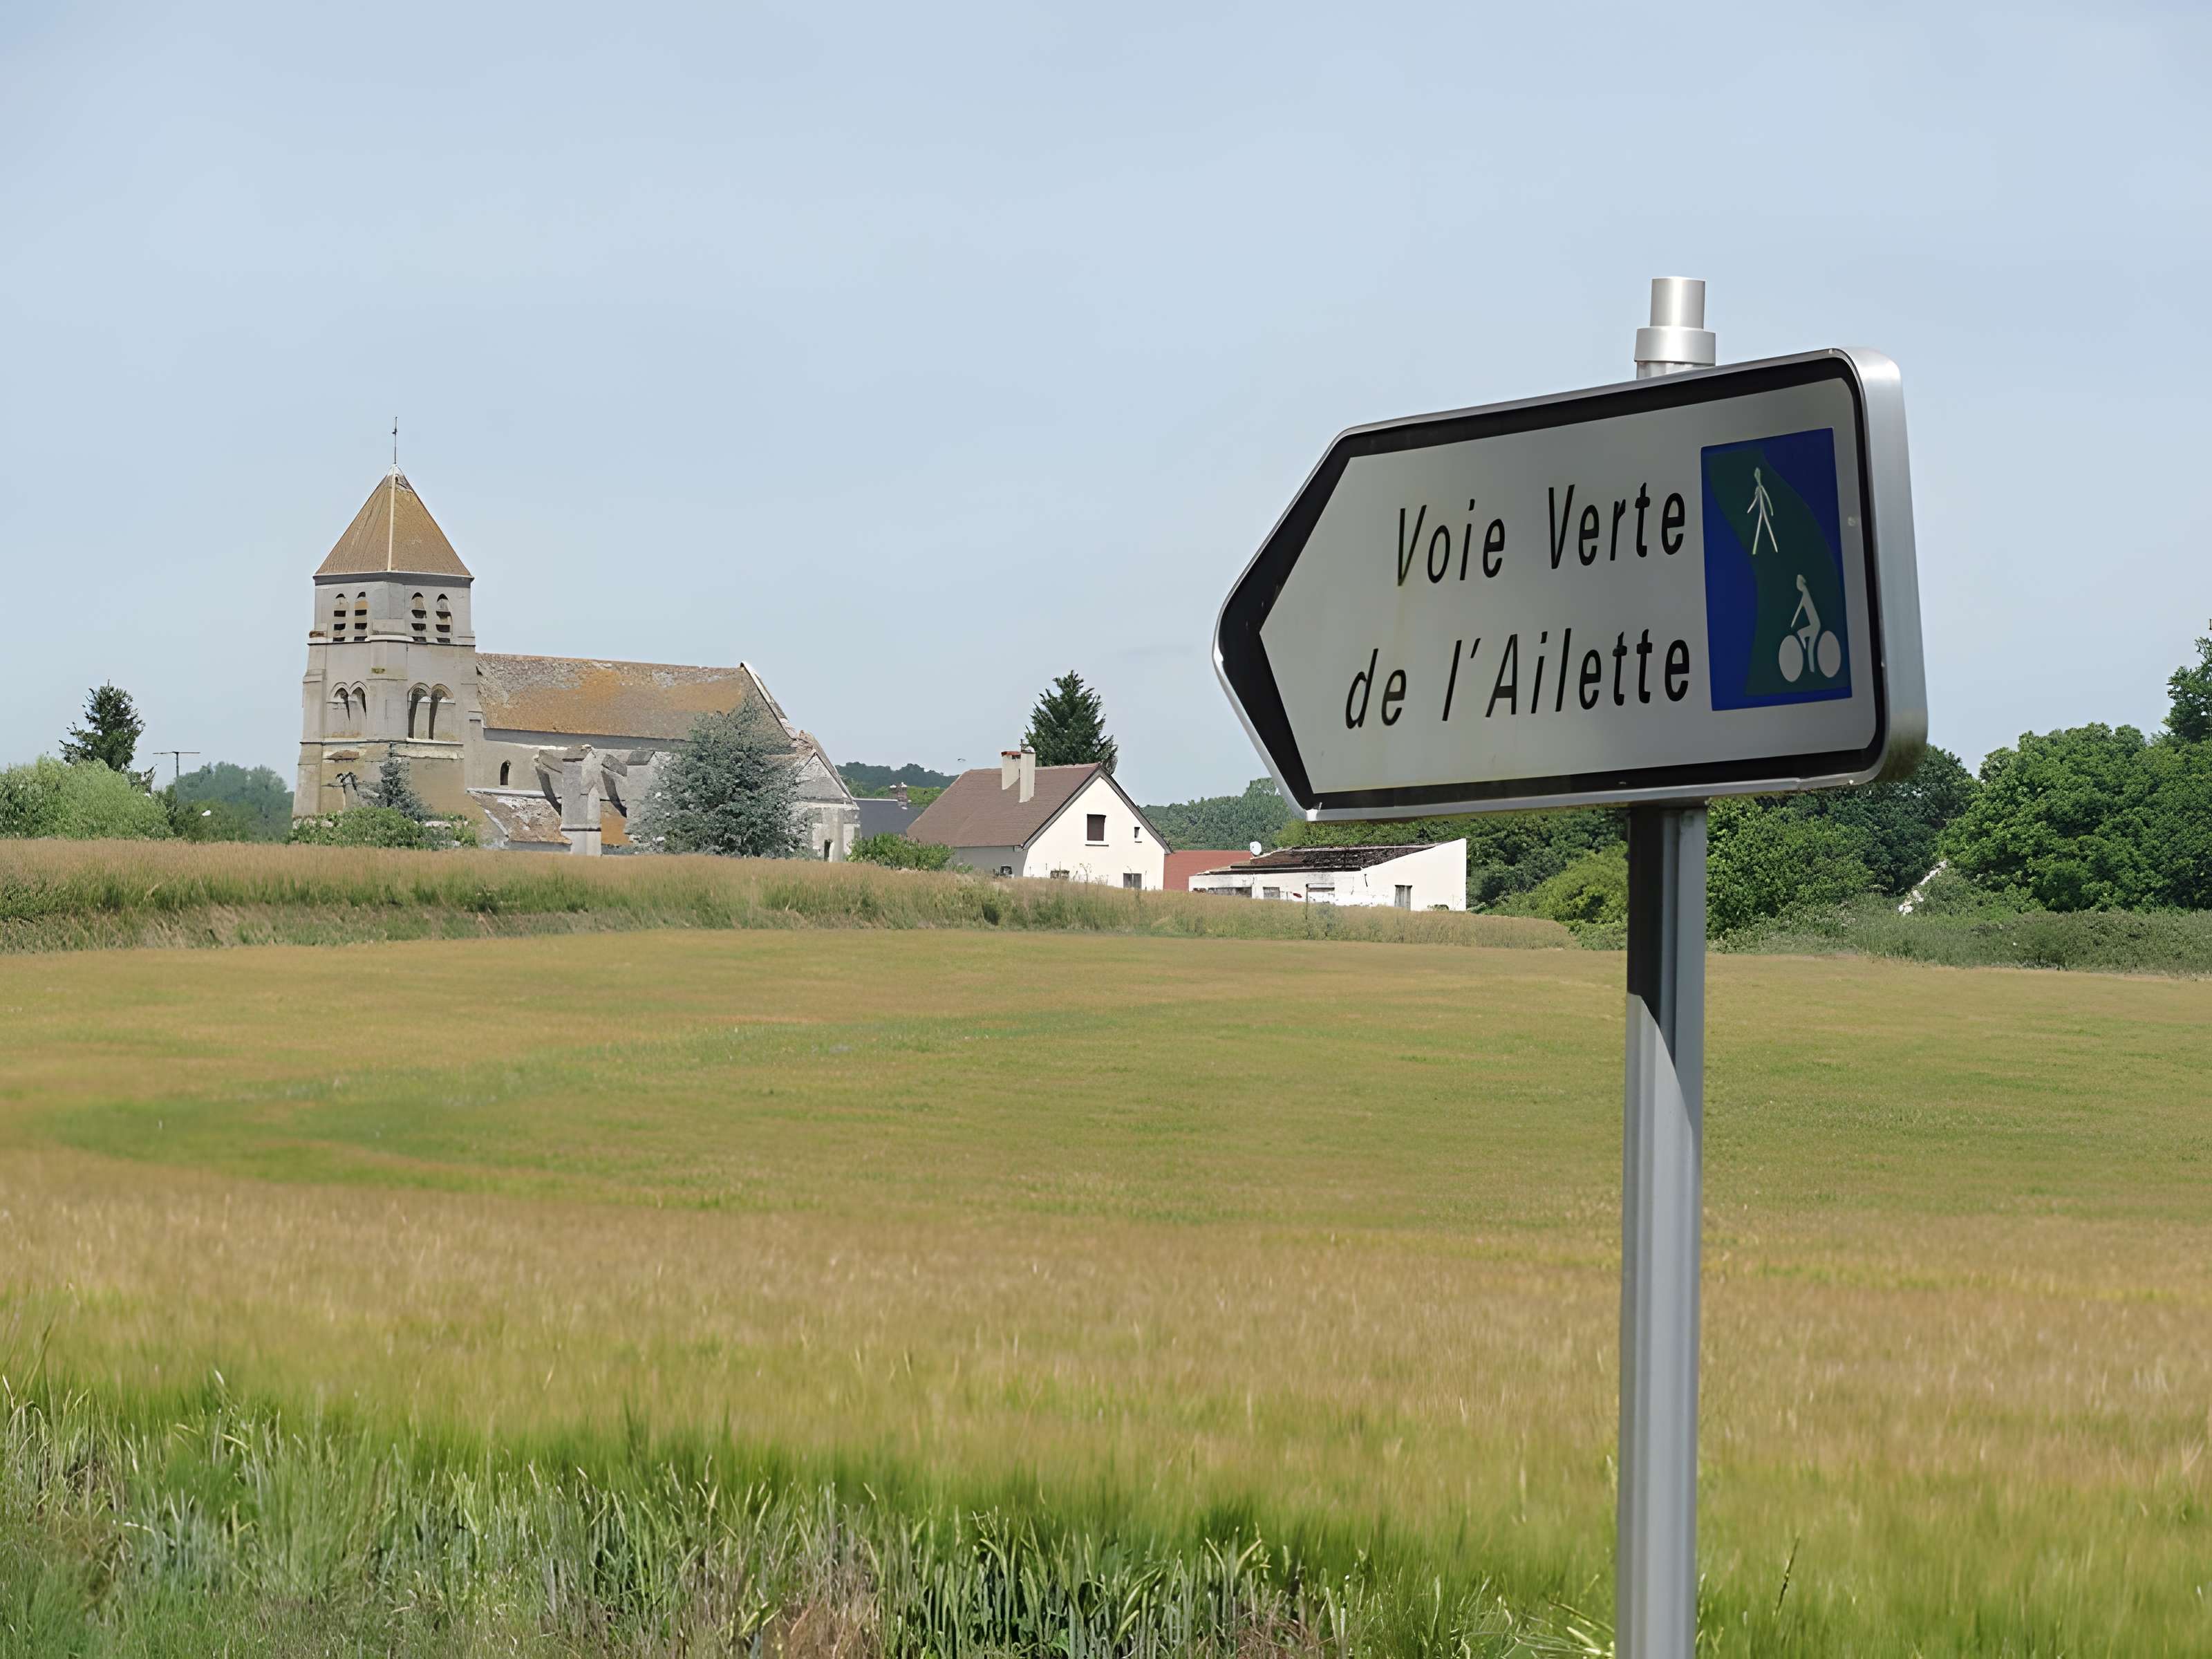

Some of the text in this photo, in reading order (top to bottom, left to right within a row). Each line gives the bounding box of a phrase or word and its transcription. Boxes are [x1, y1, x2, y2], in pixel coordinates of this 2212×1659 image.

[1397, 481, 1687, 588] Voie Verte
[1344, 627, 1691, 730] de l'Ailette
